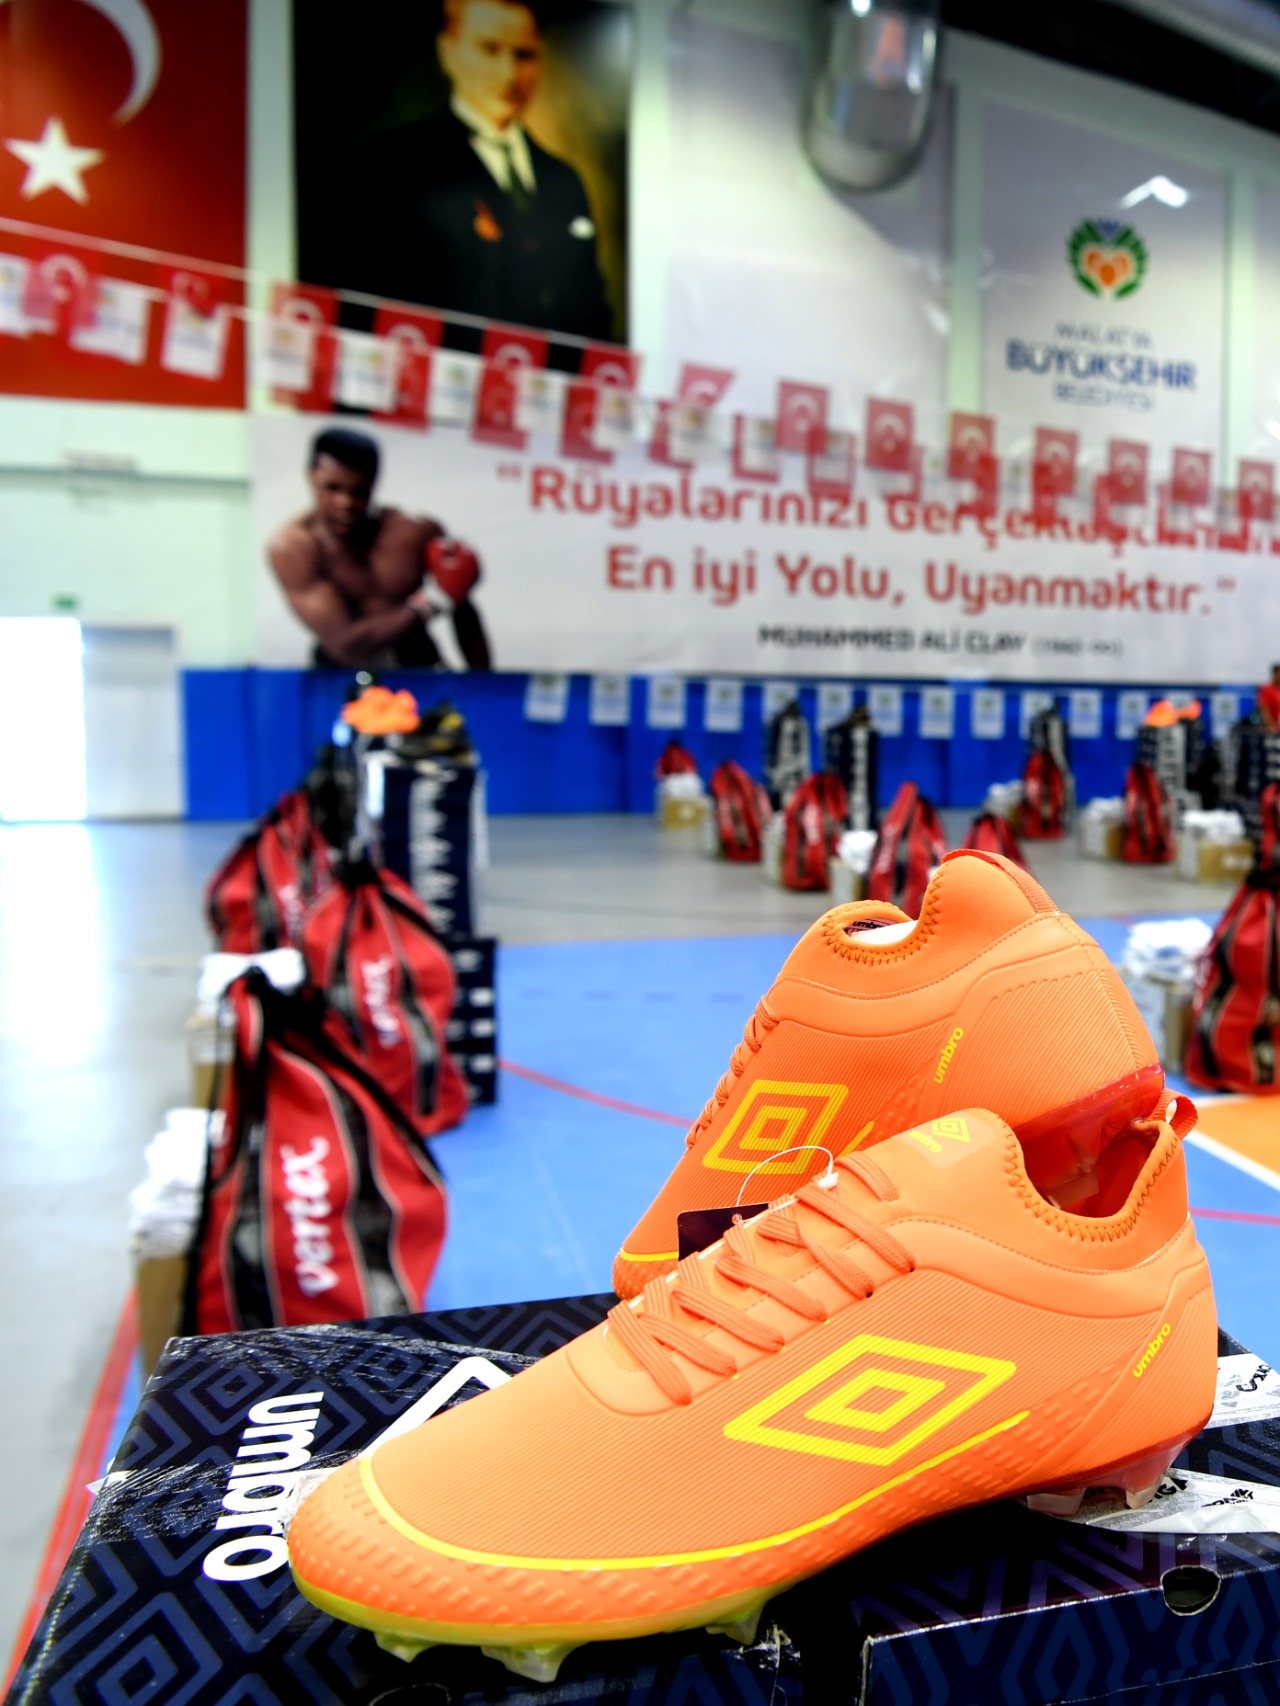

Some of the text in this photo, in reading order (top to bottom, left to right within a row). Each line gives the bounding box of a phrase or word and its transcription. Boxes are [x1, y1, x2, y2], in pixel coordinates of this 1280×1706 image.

[606, 544, 673, 592] En
[694, 547, 756, 606] iyi
[776, 553, 904, 606] Yolu,
[933, 1027, 964, 1084] umbro
[1132, 1322, 1171, 1378] umbro
[202, 1391, 325, 1581] umbro
